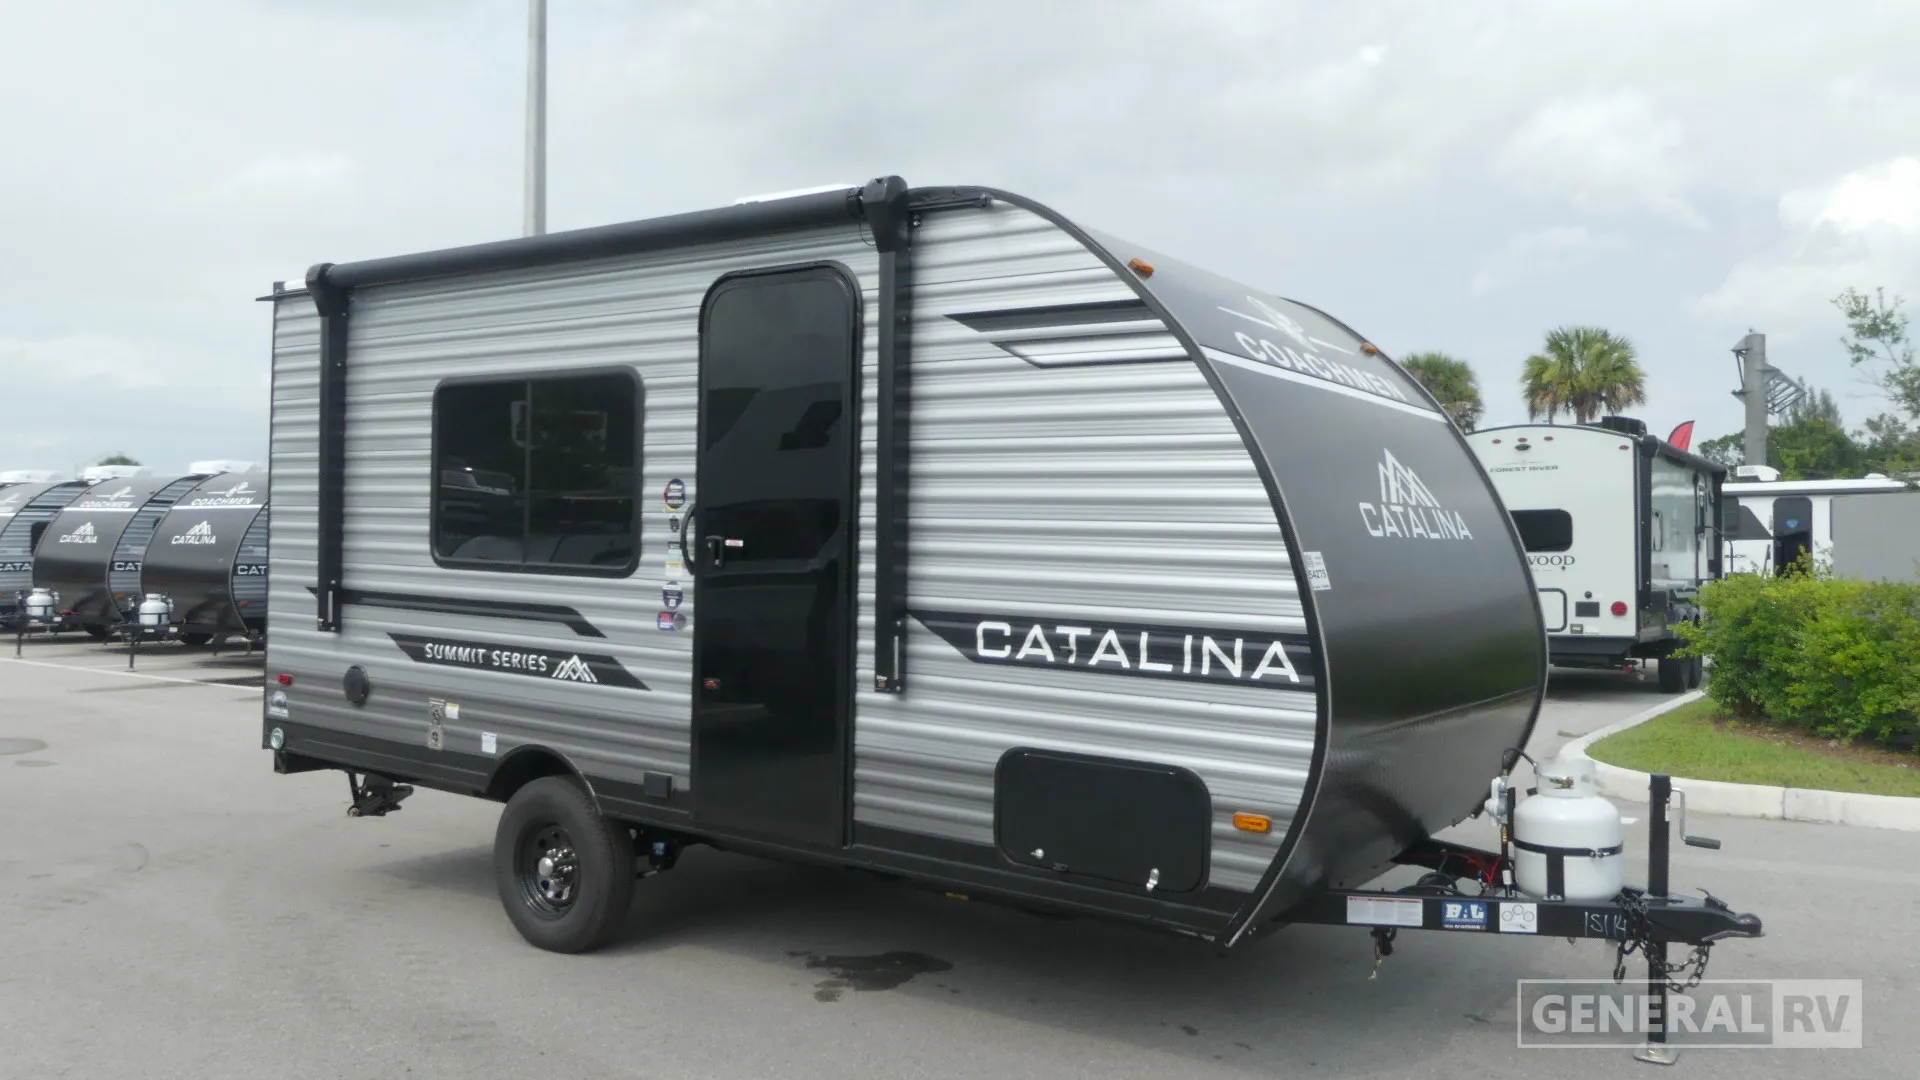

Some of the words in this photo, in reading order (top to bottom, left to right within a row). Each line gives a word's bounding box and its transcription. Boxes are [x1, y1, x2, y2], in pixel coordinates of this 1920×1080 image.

[1234, 331, 1408, 401] COACHMEN
[190, 497, 254, 506] COACHMEN
[1359, 501, 1474, 541] CATALINA
[58, 533, 97, 544] CATALINA
[171, 535, 217, 545] CATALINA
[237, 565, 267, 575] CAT
[424, 643, 486, 665] SUMMIT
[492, 650, 548, 672] SERIES
[975, 621, 1300, 683] CATALINA
